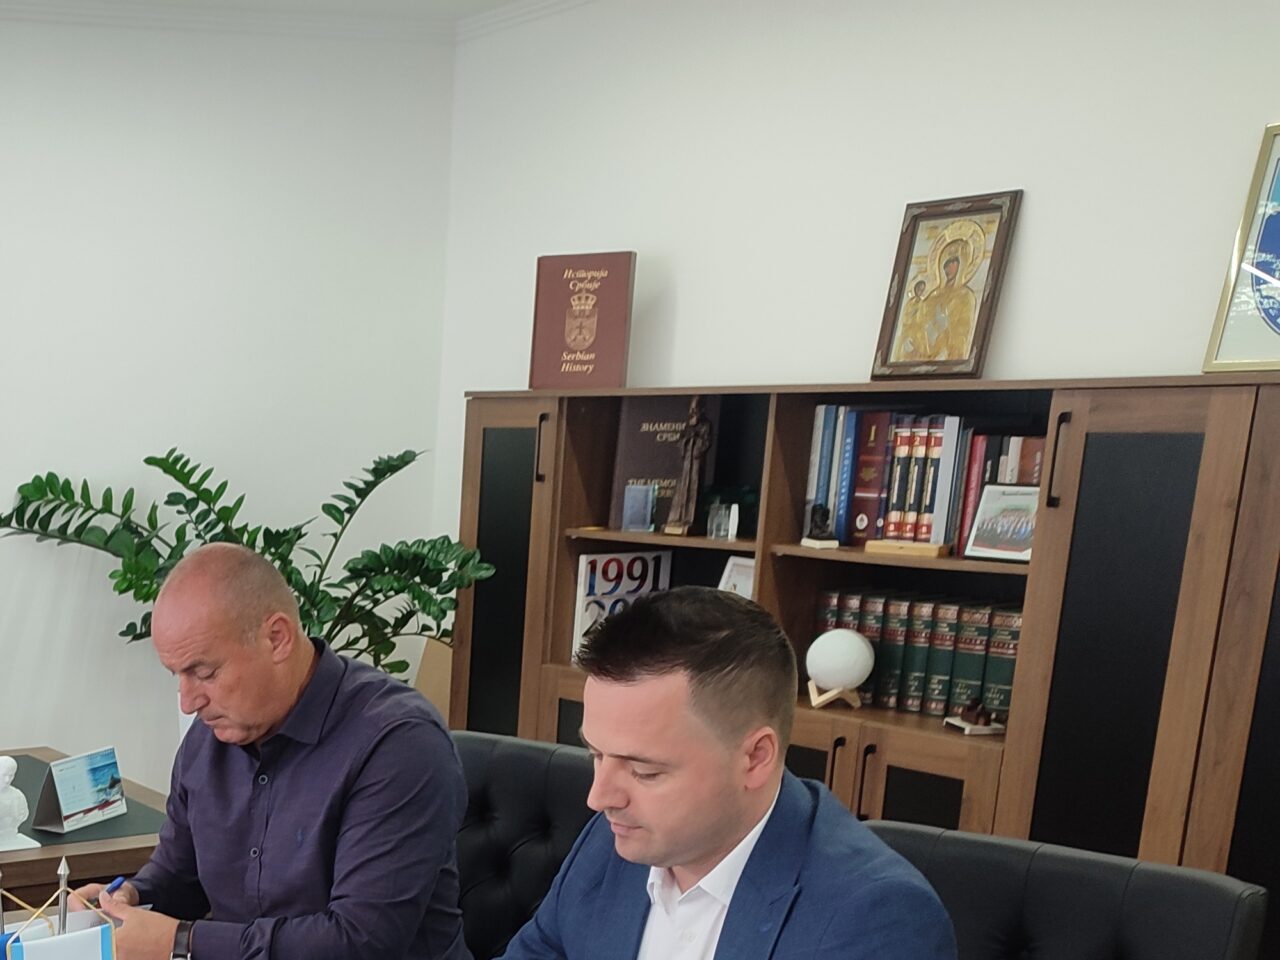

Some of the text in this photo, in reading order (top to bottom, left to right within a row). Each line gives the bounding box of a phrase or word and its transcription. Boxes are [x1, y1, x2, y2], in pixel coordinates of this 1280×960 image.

[569, 279, 601, 292] Србије
[561, 351, 596, 361] Serbian
[560, 363, 594, 374] History
[640, 422, 687, 432] ЗНАМЕНИ
[586, 555, 662, 596] 1991
